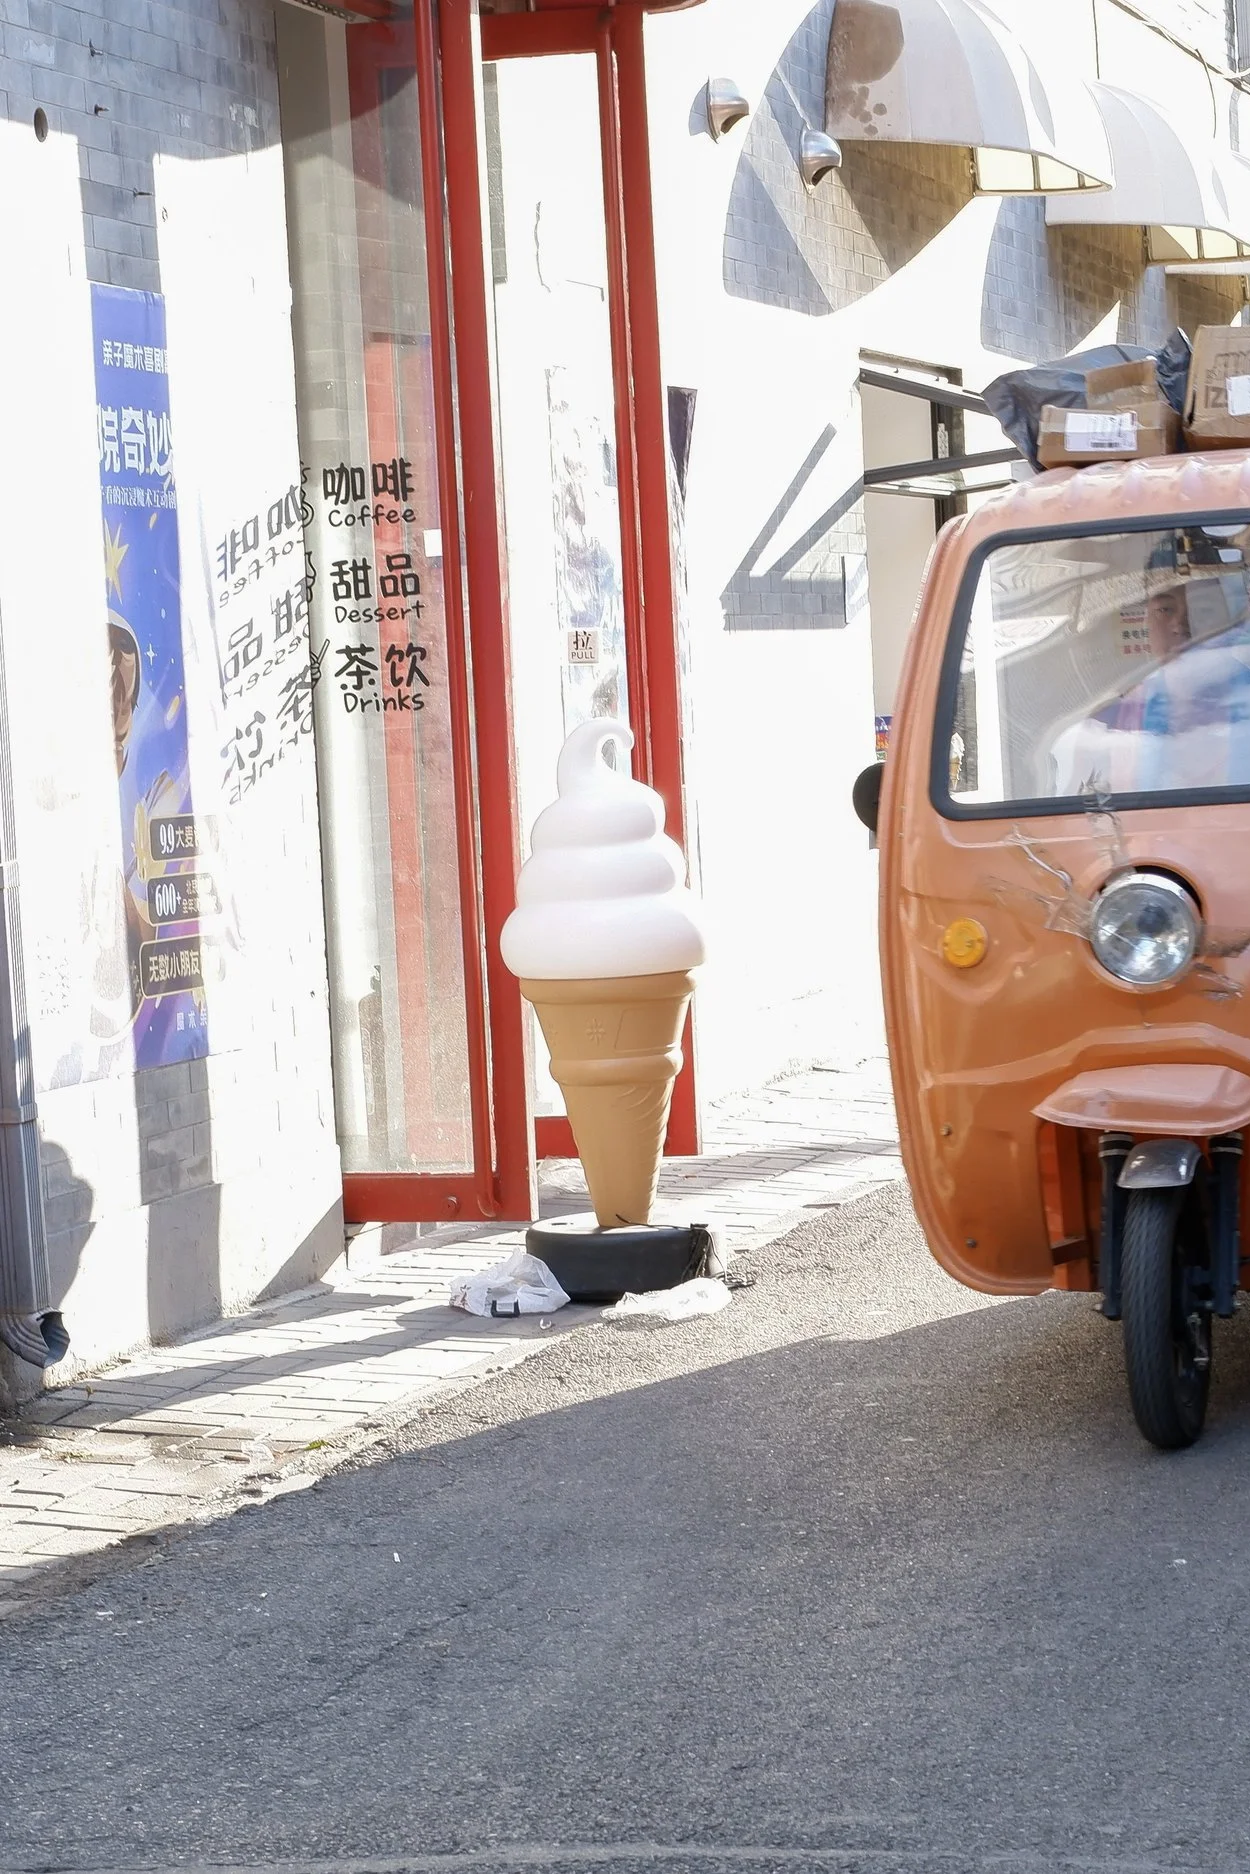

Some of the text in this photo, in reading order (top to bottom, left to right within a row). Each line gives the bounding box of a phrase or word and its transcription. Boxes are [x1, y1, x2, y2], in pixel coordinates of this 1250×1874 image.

[102, 339, 169, 374] 亲子魔术喜剧
[322, 457, 415, 505] 咖啡
[328, 504, 416, 527] Coffee
[330, 553, 420, 601] 甜品
[335, 600, 425, 623] Dessert
[573, 630, 593, 650] 拉
[334, 643, 430, 690] 茶饮
[571, 651, 595, 659] PULL
[343, 689, 425, 713] Drinks
[155, 883, 182, 917] 600+
